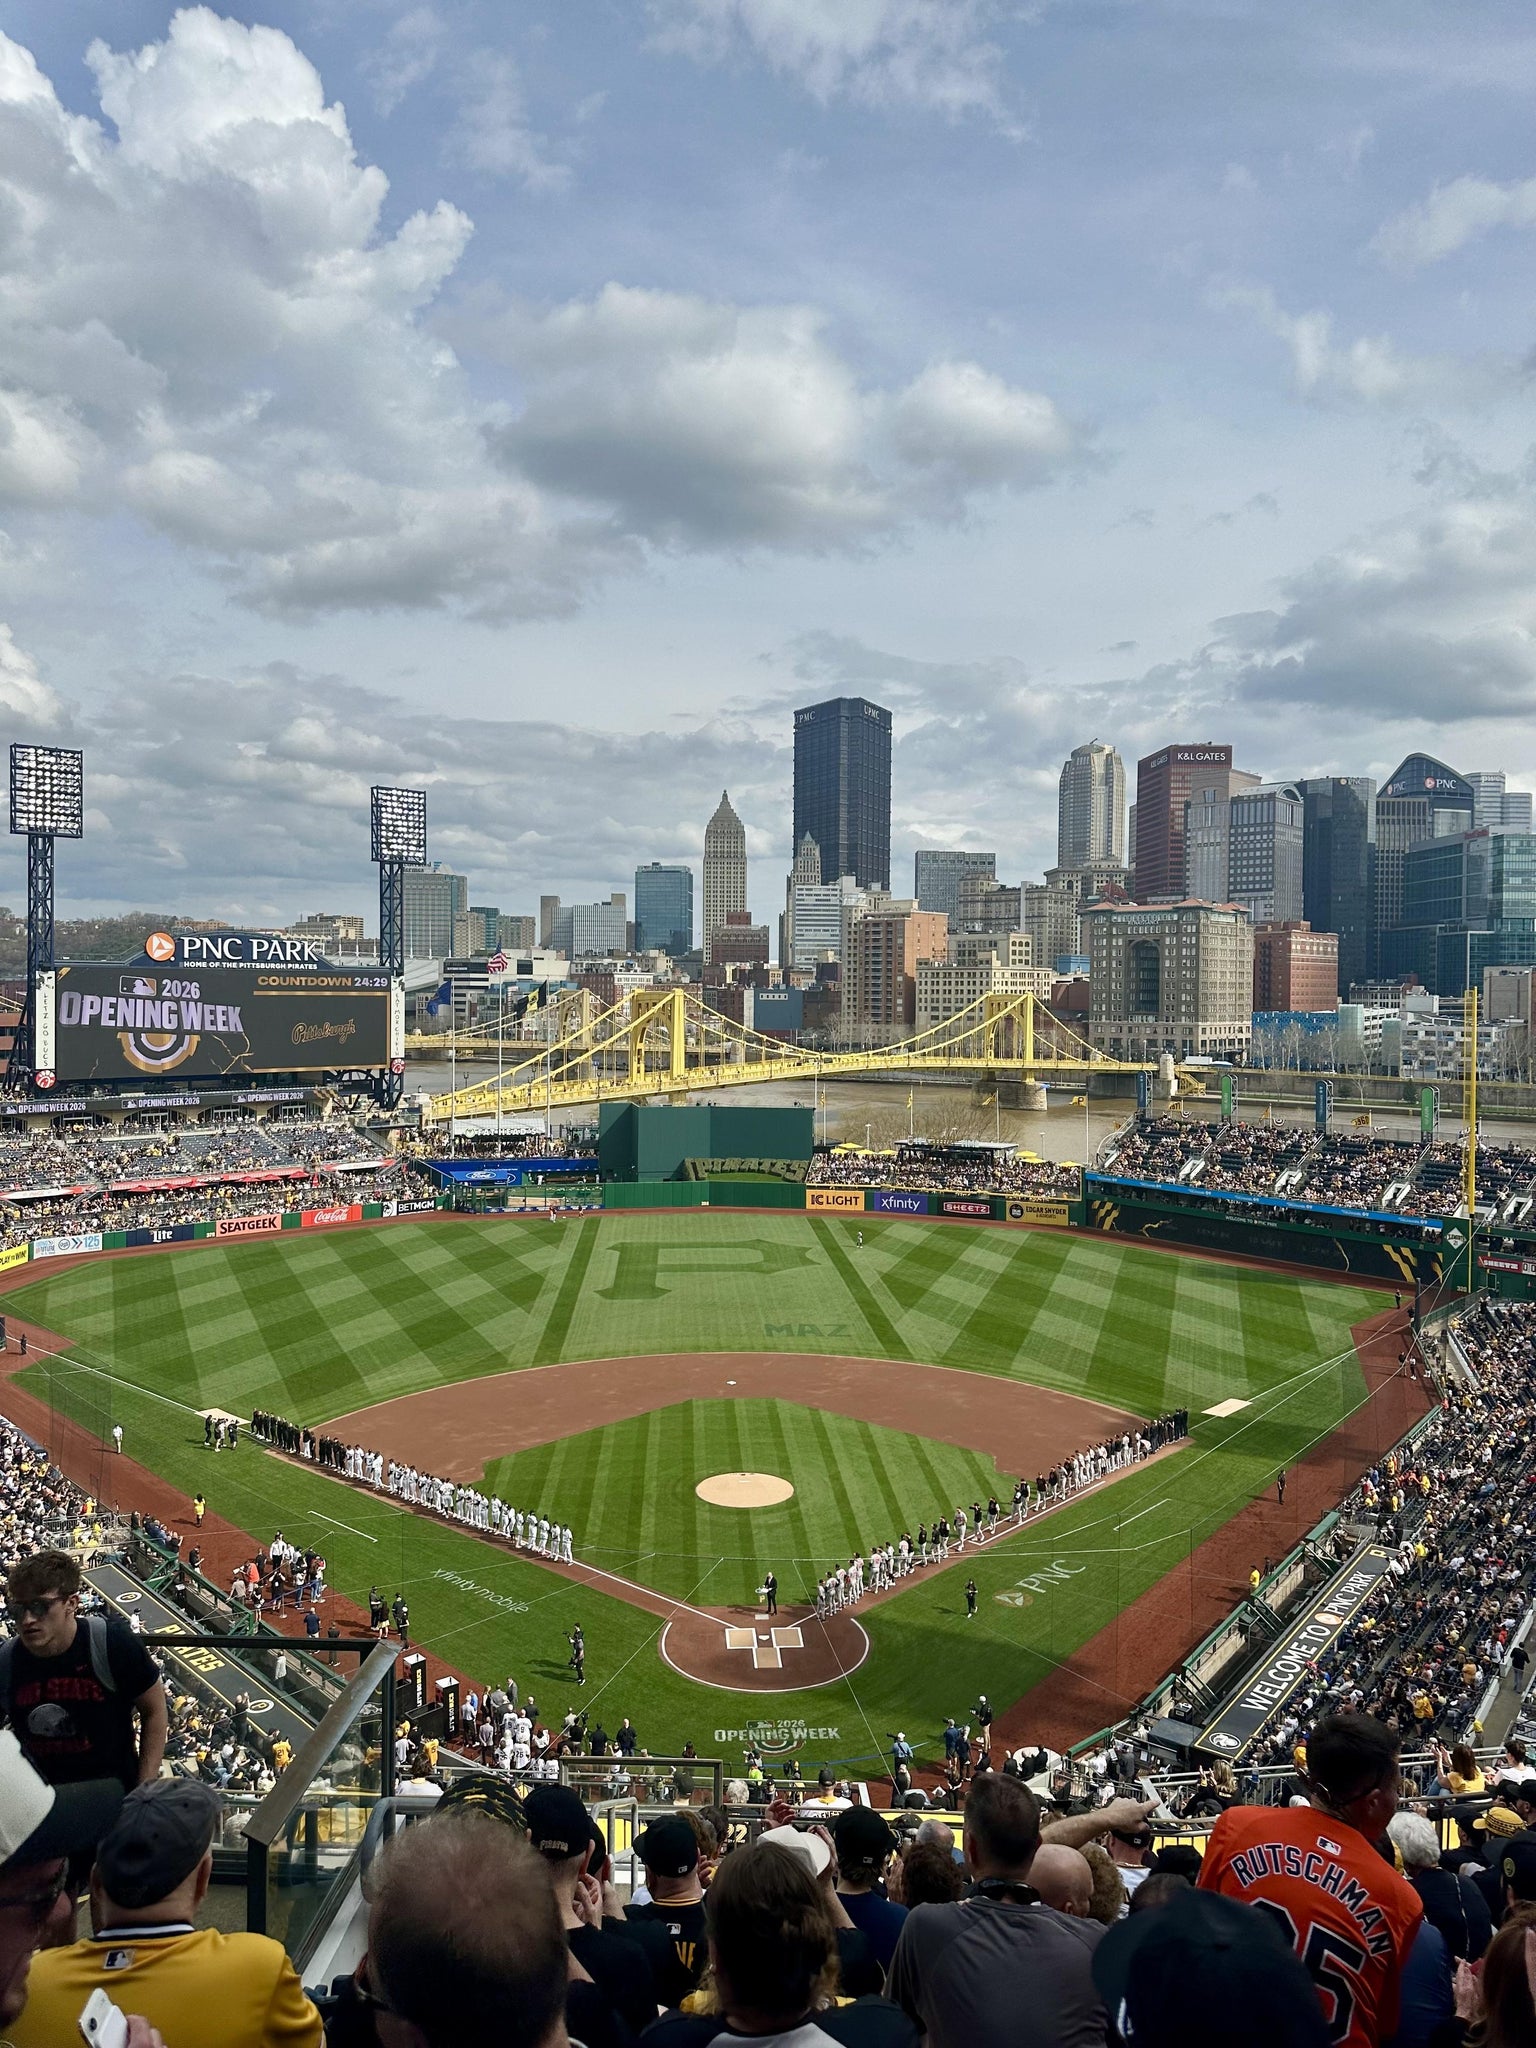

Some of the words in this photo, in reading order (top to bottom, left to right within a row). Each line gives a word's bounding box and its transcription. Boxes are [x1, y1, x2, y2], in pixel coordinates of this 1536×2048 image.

[864, 705, 880, 719] UPMC
[1177, 752, 1194, 760] K&L
[1195, 752, 1226, 761] GATES
[1393, 781, 1406, 792] PNC
[1436, 779, 1457, 789] PNC
[180, 936, 242, 960] PNC
[249, 938, 318, 962] PARK
[222, 961, 237, 969] THE
[239, 961, 286, 969] PITTSBURGH
[287, 962, 318, 970] PIRATES
[257, 976, 352, 986] COUNTDOWN
[354, 977, 389, 987] 24:29
[161, 978, 200, 999] 2026
[58, 991, 178, 1031] OPENING
[179, 1000, 244, 1033] WEEK
[291, 1018, 356, 1045] Pittsburgh
[138, 1099, 166, 1108] OPENING
[166, 1097, 184, 1106] WEEK
[184, 1096, 200, 1105] 2026
[247, 1093, 273, 1102] OPENING
[273, 1092, 290, 1101] WEEK
[289, 1091, 304, 1100] 2026
[18, 1103, 49, 1114] OPENING
[49, 1103, 69, 1112] WEEK
[69, 1102, 86, 1111] 2026
[685, 1158, 809, 1181] PIRATES
[398, 1200, 435, 1212] BETMGM
[826, 1195, 860, 1206] LIGHT
[881, 1195, 921, 1211] xfinity
[946, 1202, 987, 1213] SHEETZ
[1025, 1205, 1044, 1214] EDGAR
[1045, 1207, 1067, 1215] SNYDER
[314, 1208, 350, 1224] Coca-Cola
[220, 1217, 278, 1234] SEATGEEK
[83, 1235, 100, 1248] 125
[151, 1230, 173, 1243] Lite
[764, 1323, 852, 1337] MAZ
[1014, 1560, 1086, 1593] PNC
[430, 1568, 481, 1591] xfinity
[474, 1588, 529, 1614] mobile
[1240, 1641, 1318, 1711] WELCOME
[1298, 1624, 1331, 1643] TO
[1323, 1593, 1357, 1616] PNC
[1344, 1570, 1376, 1595] PARK
[777, 1719, 806, 1728] 2026
[714, 1729, 789, 1742] OPENING
[790, 1727, 841, 1740] WEEK
[1230, 1842, 1392, 1957] RUTSCHMAN
